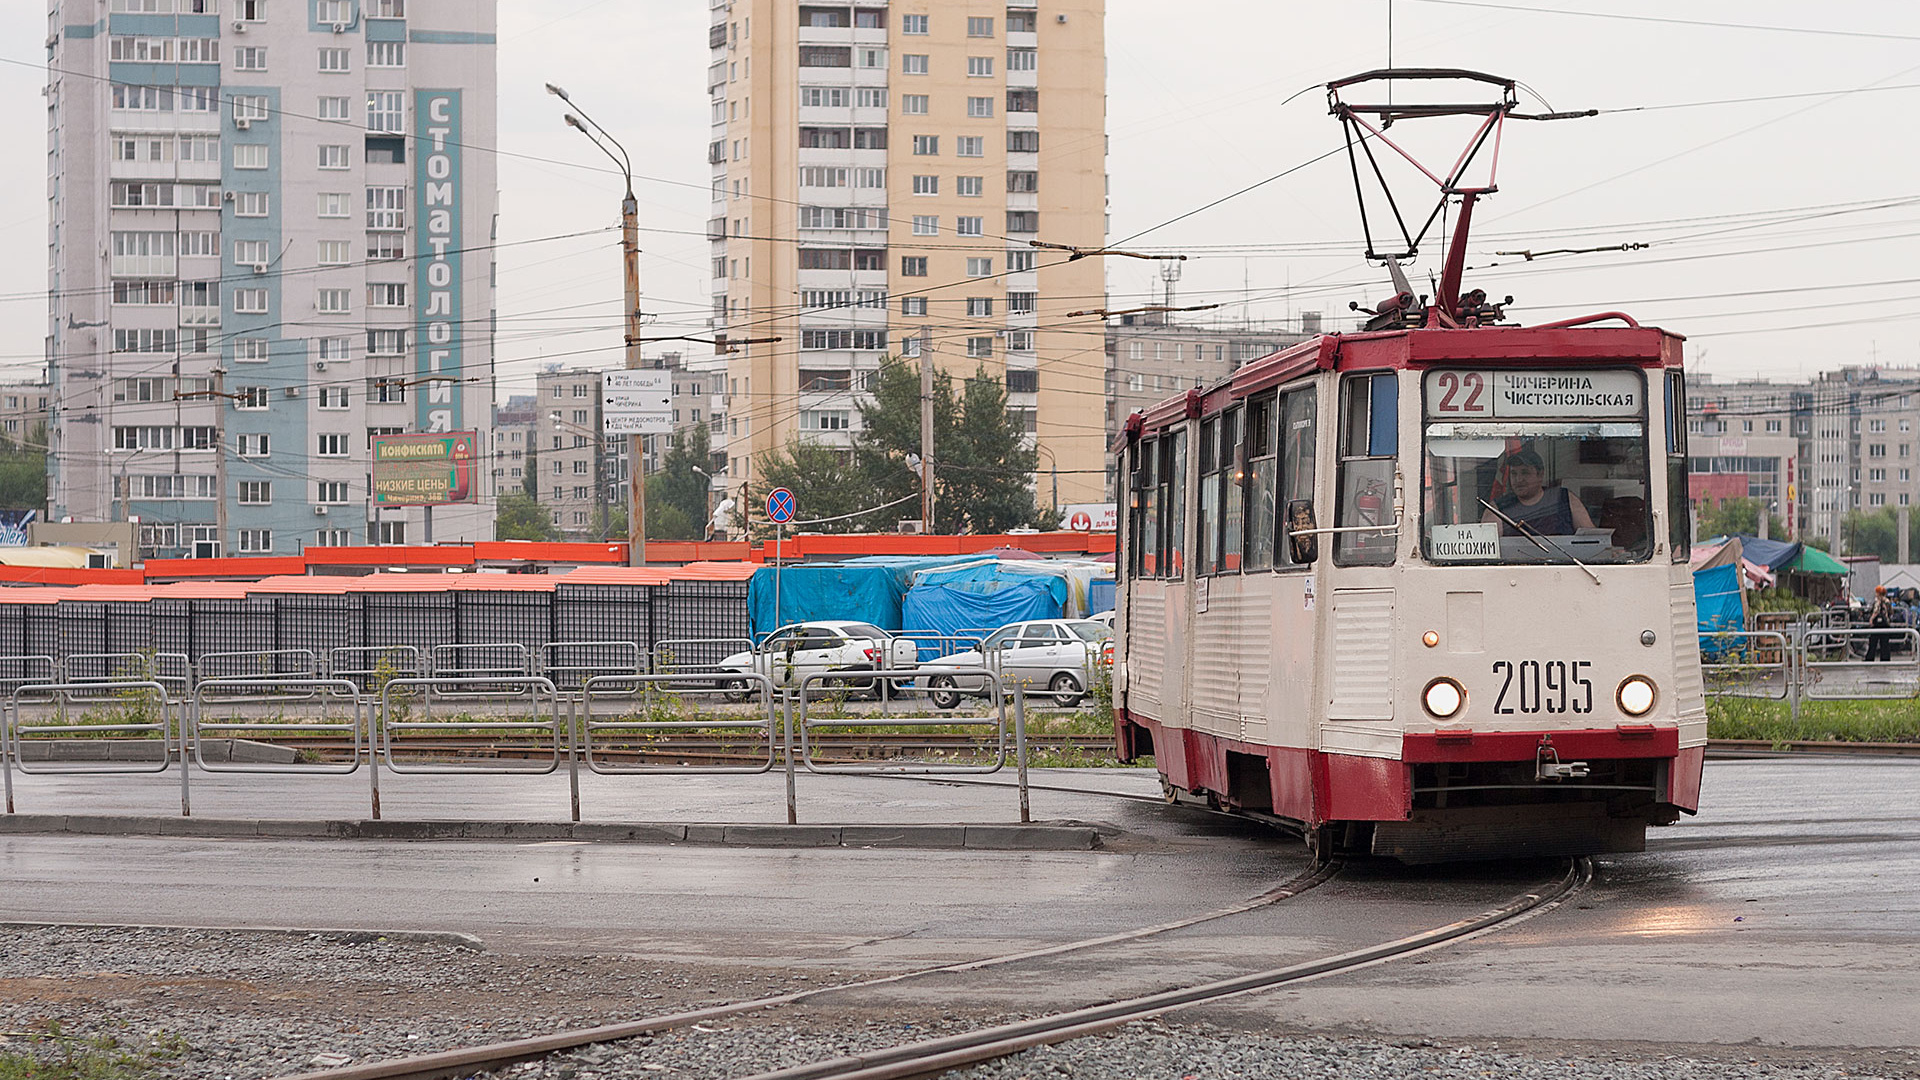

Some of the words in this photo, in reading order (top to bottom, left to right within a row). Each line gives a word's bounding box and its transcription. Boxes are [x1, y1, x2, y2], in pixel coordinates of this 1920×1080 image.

[1504, 375, 1593, 390] ЧИЧЕРИНА
[1438, 372, 1484, 412] 22
[1504, 391, 1634, 406] ЧИСТОПОЛЬСКАЯ
[381, 443, 443, 457] КОНФИСКАТА
[375, 479, 415, 492] НИЗКИЕ
[416, 478, 448, 491] ЦЕНЫ
[1457, 530, 1473, 540] НА
[1436, 541, 1496, 556] КОКСОХИМ
[1493, 660, 1593, 715] 2095
